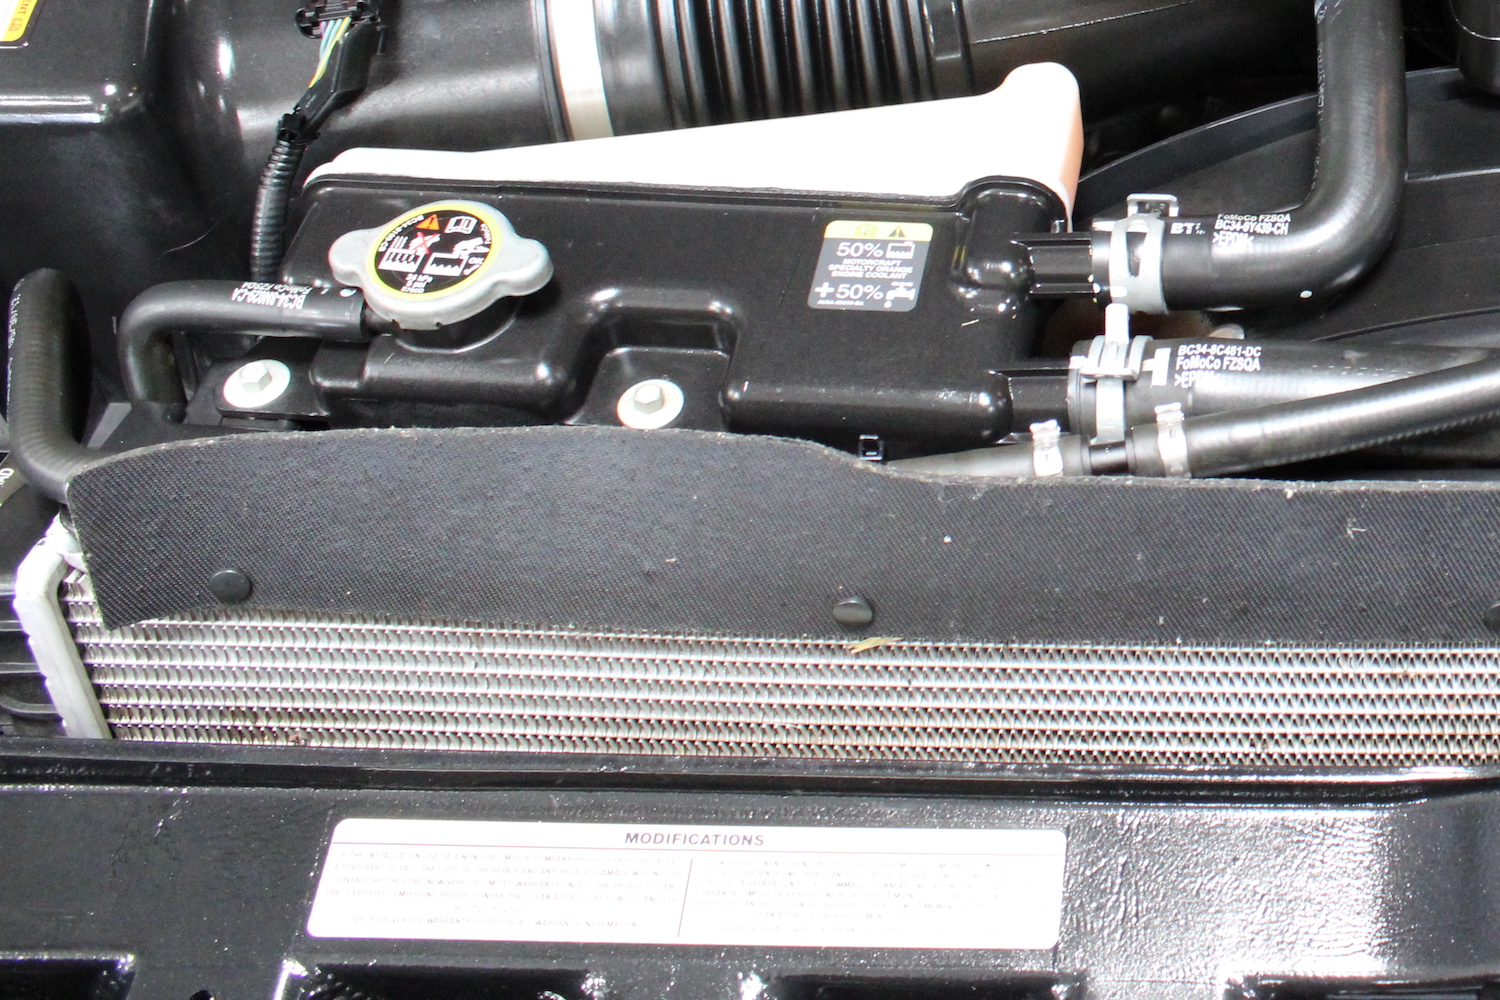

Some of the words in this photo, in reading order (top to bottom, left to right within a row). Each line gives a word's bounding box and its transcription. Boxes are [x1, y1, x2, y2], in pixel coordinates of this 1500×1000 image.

[836, 242, 884, 258] 50%
[828, 264, 875, 272] SPECIALTY
[875, 266, 913, 274] ORANGE
[831, 270, 864, 278] ENGINE
[865, 271, 908, 279] COOLANT
[1177, 343, 1262, 357] BC34-8C481-DC
[1175, 354, 1222, 371] FoMoCo
[1222, 356, 1261, 372] FZSQA
[624, 832, 765, 846] MODIFICATIONS
